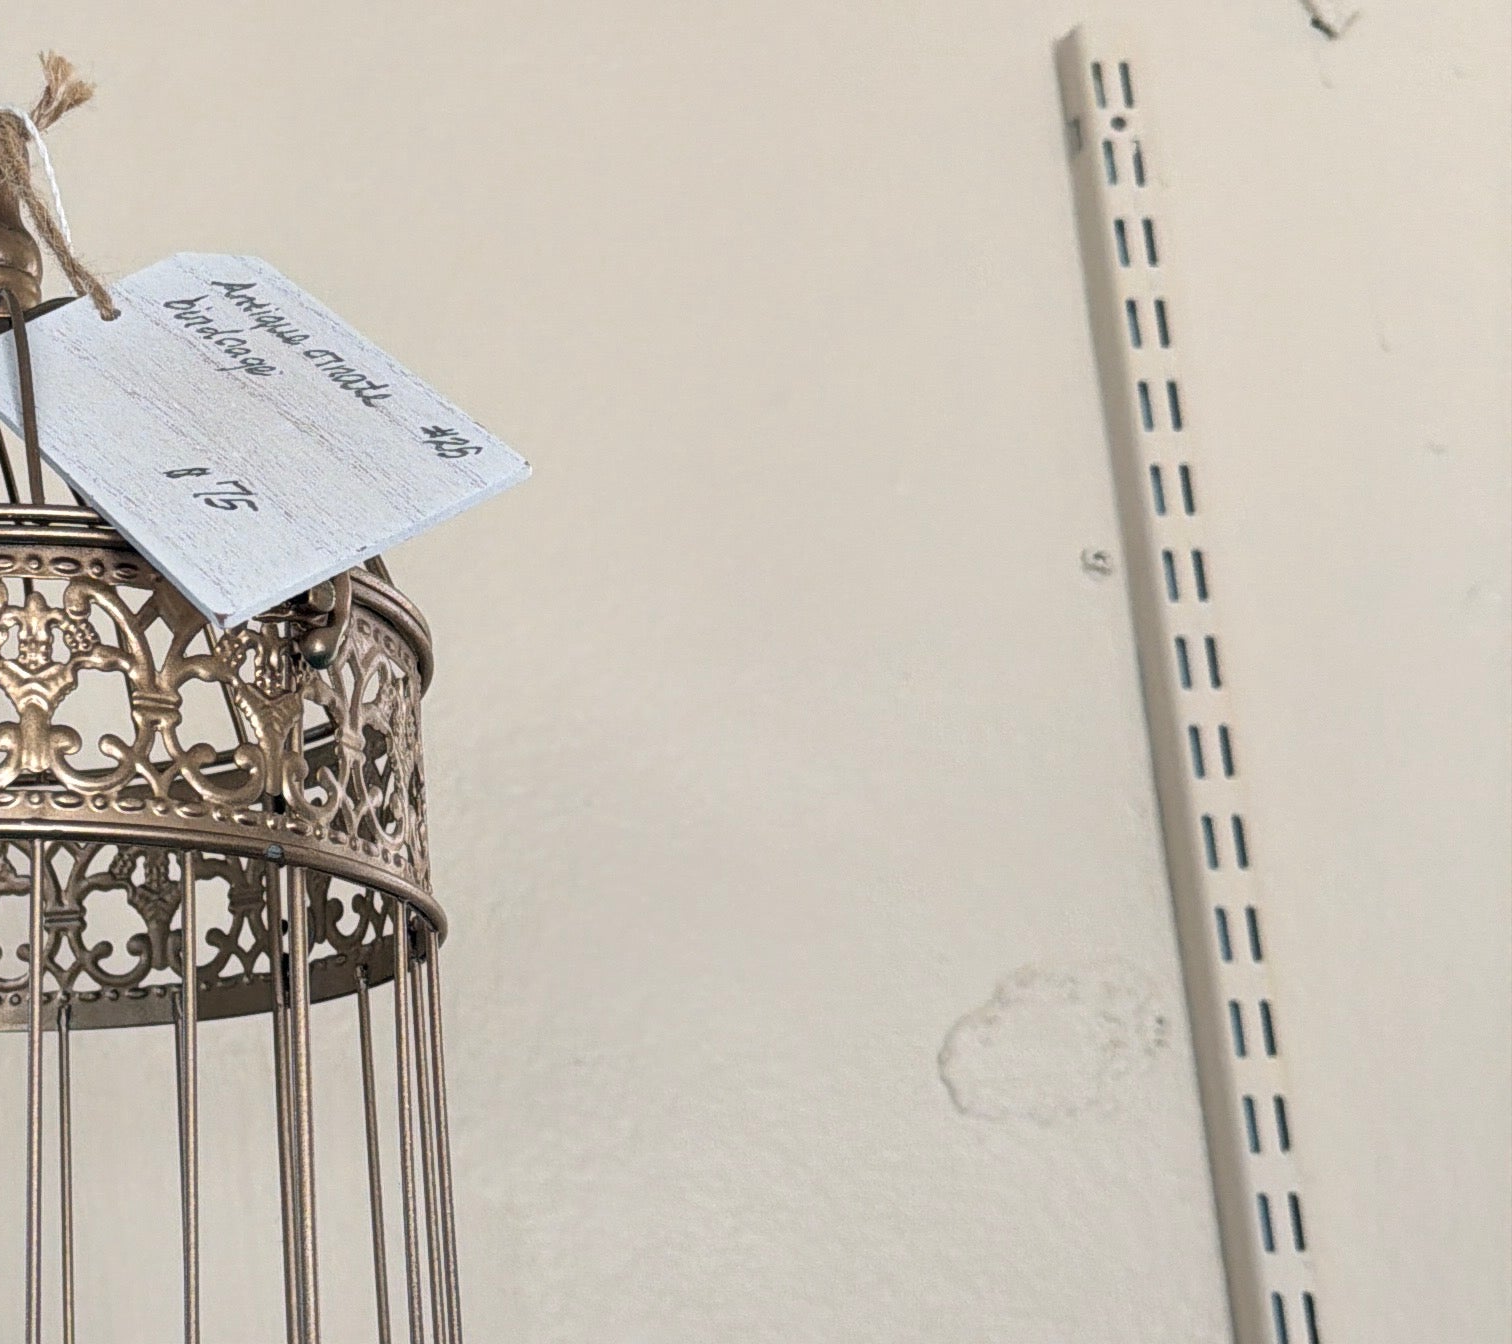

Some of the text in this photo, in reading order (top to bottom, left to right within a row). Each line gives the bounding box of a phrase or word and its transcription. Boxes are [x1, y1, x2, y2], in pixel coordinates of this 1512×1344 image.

[162, 294, 278, 377] birdcage
[210, 280, 311, 346] Antique
[302, 348, 393, 408] ornate
